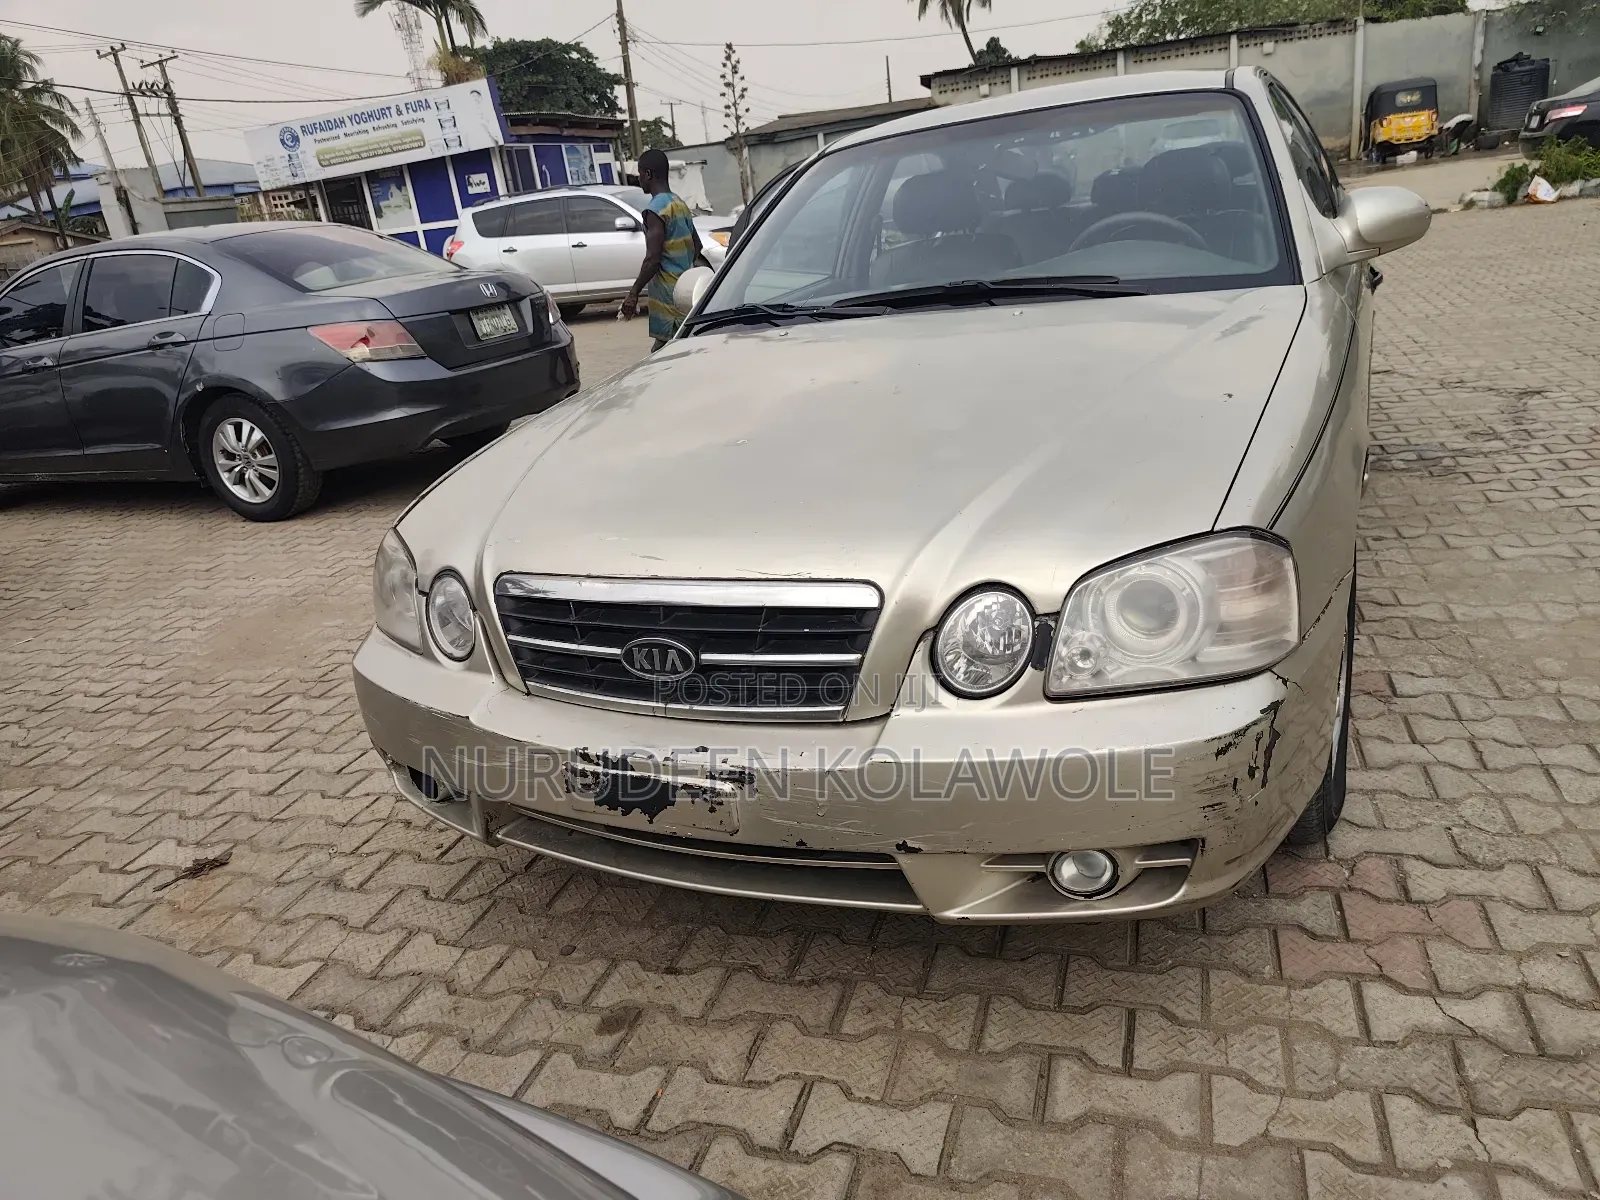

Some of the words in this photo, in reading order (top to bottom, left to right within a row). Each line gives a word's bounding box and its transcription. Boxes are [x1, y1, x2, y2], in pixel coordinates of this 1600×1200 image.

[300, 116, 347, 137] RUFAIDAH
[347, 106, 394, 127] YOGHURT
[395, 104, 404, 117] &
[404, 98, 432, 114] FURA
[343, 128, 370, 139] Nourishing
[372, 122, 398, 132] Refreshing
[400, 116, 425, 127] Satisfying
[631, 647, 685, 672] KIA
